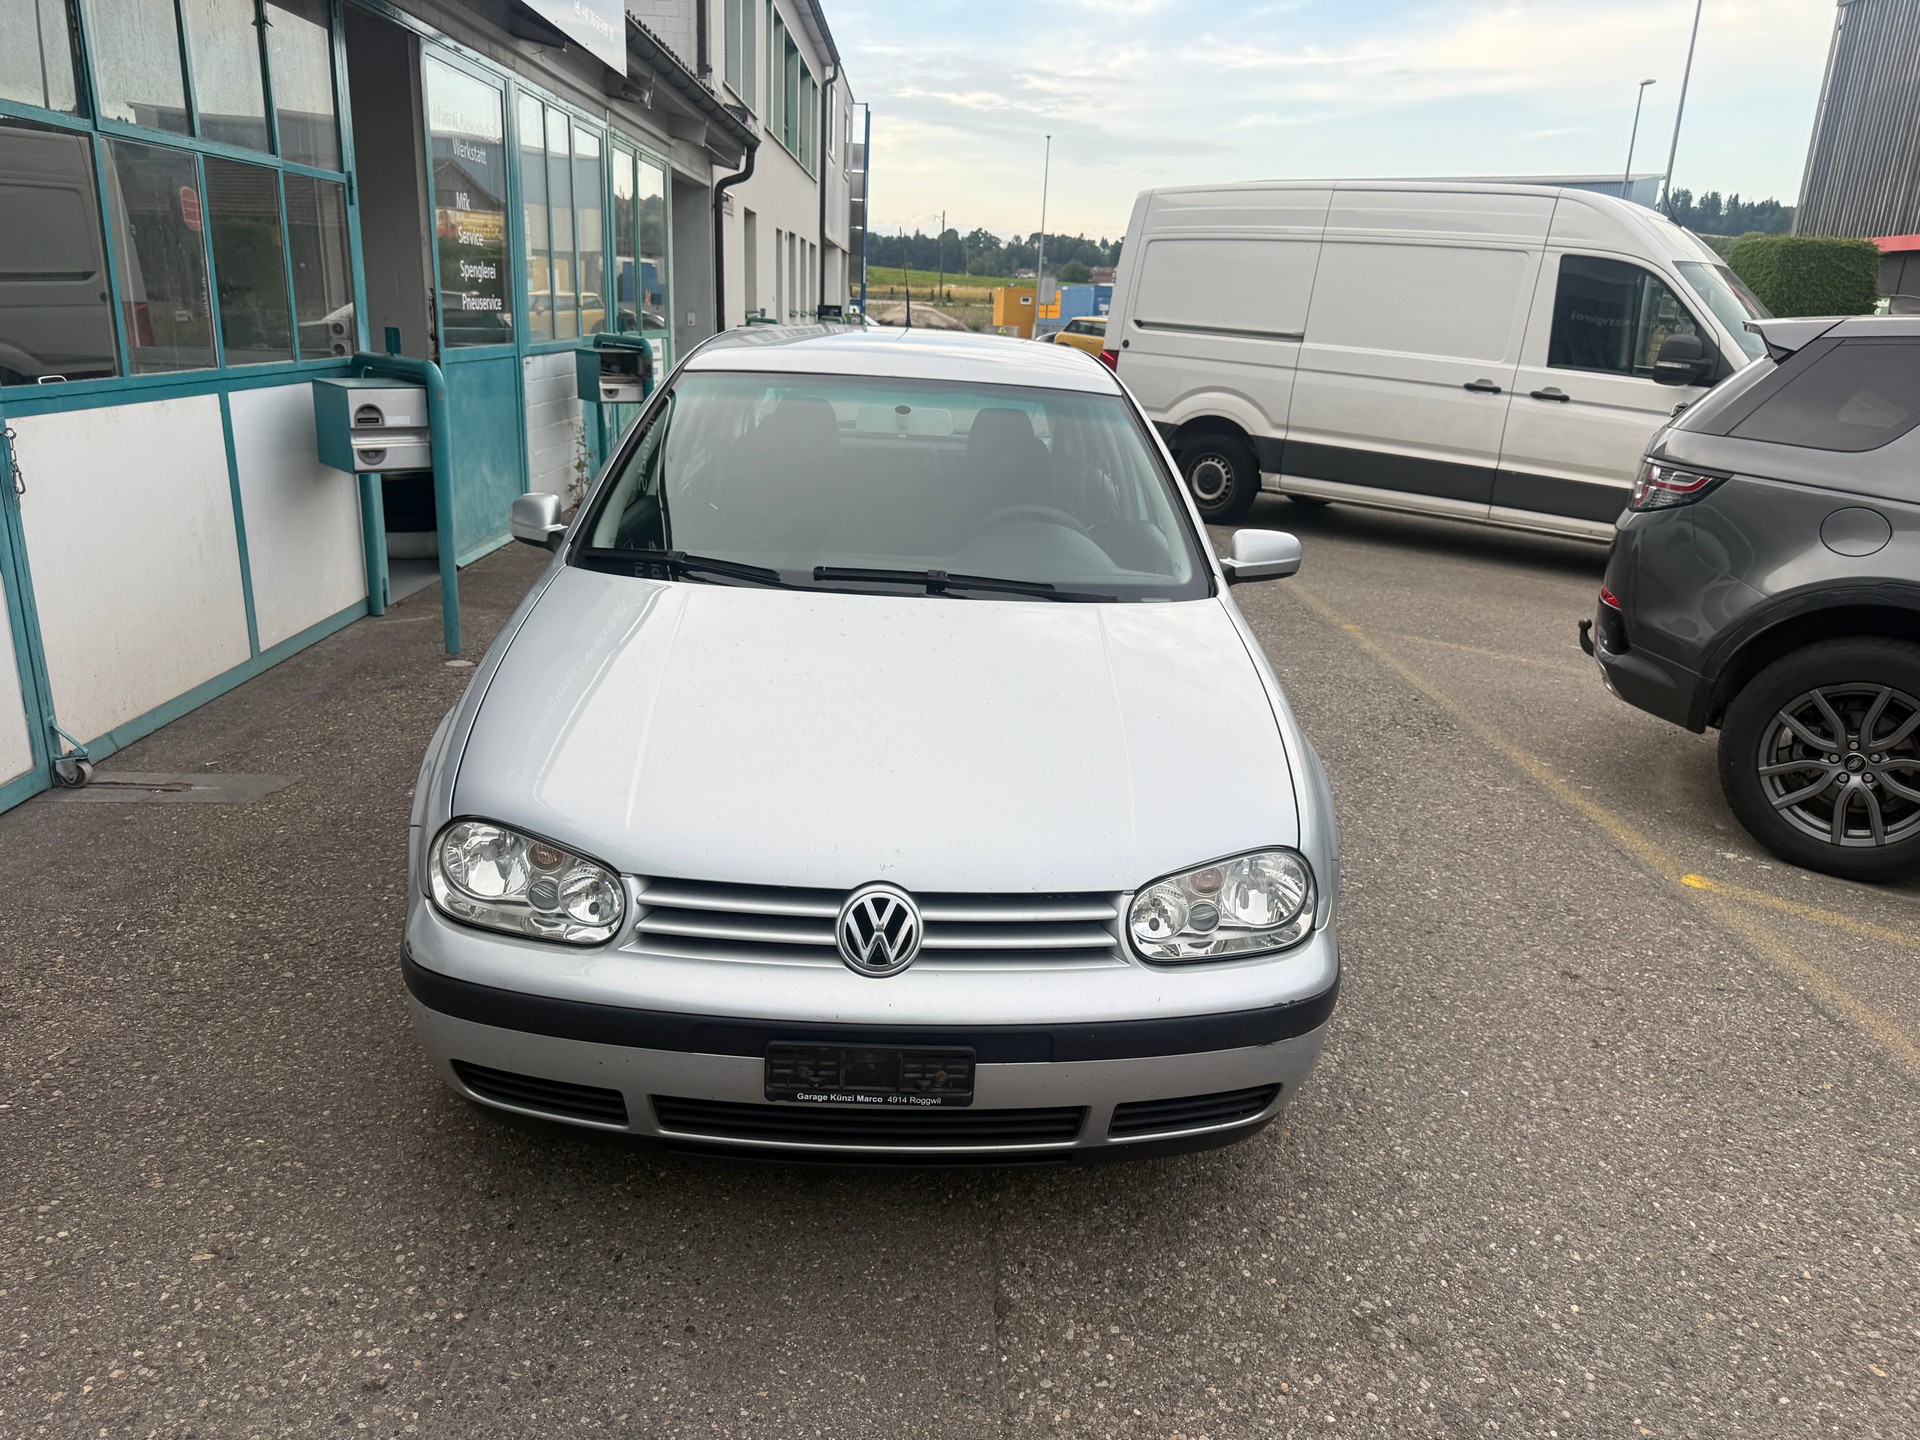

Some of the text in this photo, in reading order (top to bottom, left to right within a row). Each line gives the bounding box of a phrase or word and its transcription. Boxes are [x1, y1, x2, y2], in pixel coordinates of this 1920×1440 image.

[452, 137, 487, 165] Werkstatt
[456, 191, 471, 211] Mfk
[458, 226, 484, 246] Service
[460, 260, 496, 283] Spenglerei
[462, 293, 502, 311] Pneuservice
[842, 890, 917, 970] VW
[796, 1092, 942, 1106] Garage Künzi Marco 4914 Roggwil
